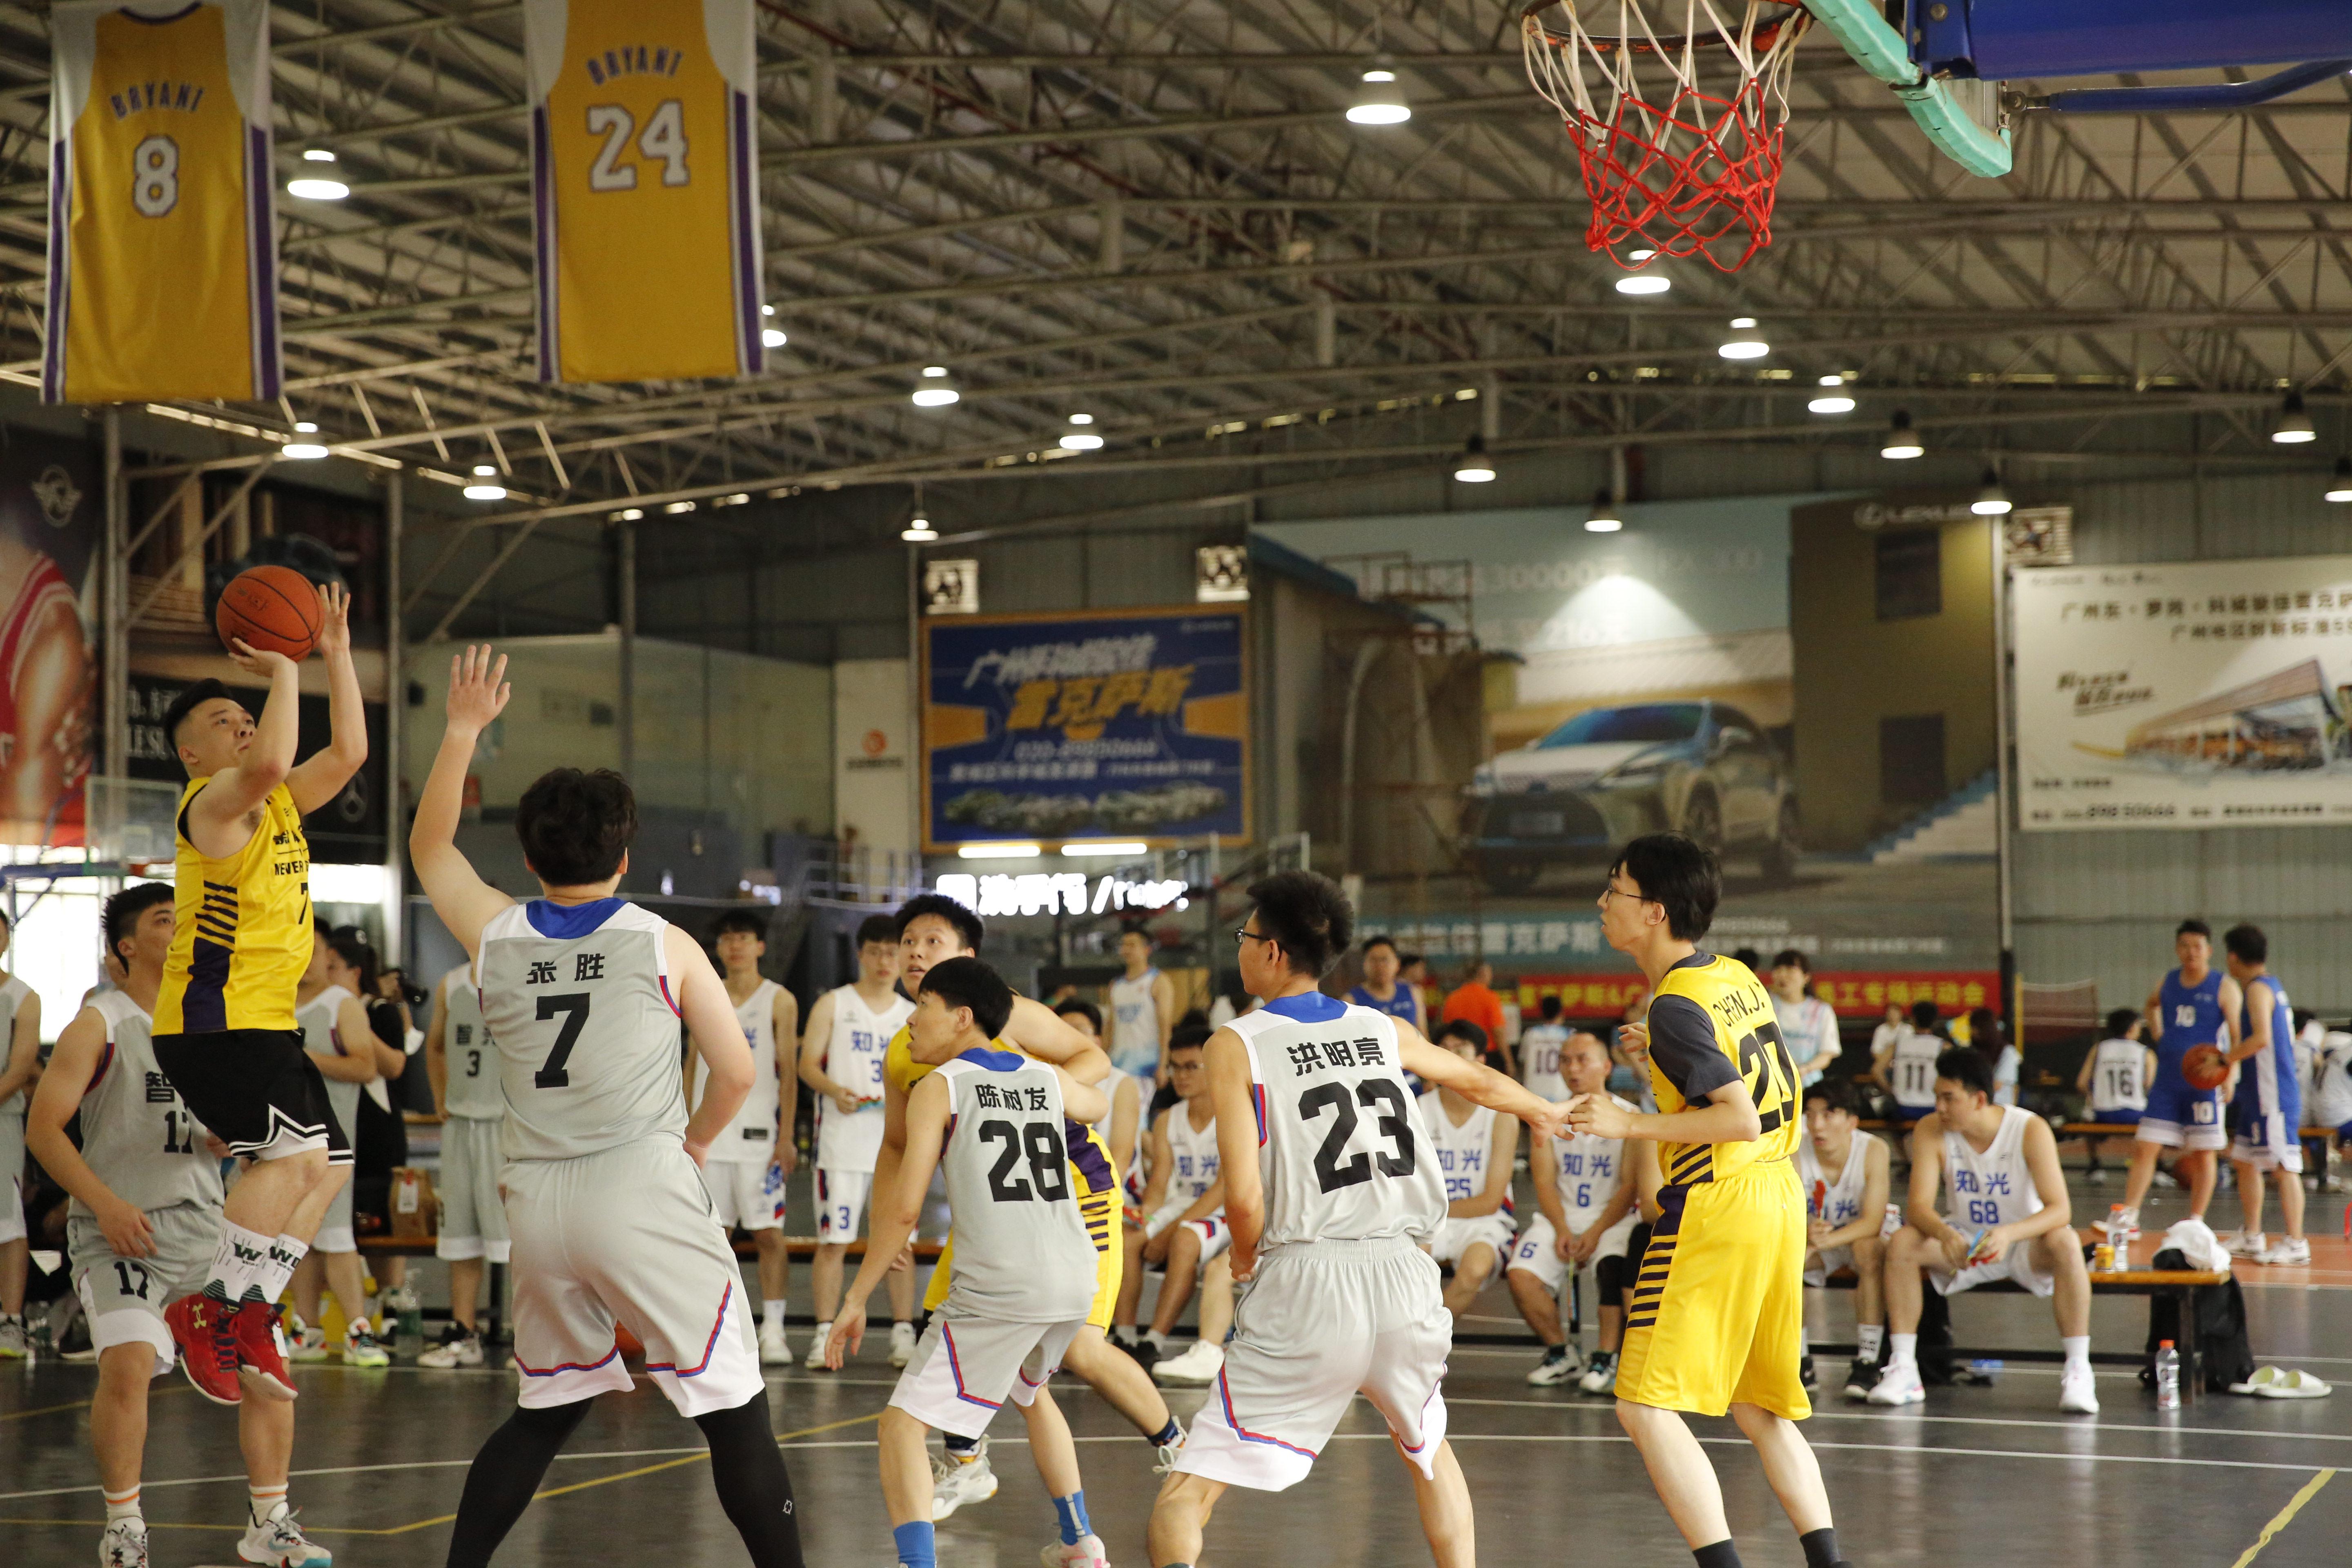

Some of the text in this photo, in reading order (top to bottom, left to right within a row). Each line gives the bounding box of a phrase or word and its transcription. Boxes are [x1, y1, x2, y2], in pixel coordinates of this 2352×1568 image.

[586, 45, 684, 85] BRYANT
[109, 80, 204, 120] BRYANT
[586, 98, 690, 192] 24
[133, 134, 179, 218] 8
[274, 861, 303, 876] NEVER
[526, 953, 605, 985] 张胜
[535, 993, 590, 1089] 7
[467, 1049, 481, 1077] 3
[871, 1060, 882, 1082] 3
[1287, 1037, 1385, 1076] 洪明亮
[1906, 1064, 1925, 1092] 11
[2107, 1068, 2134, 1098] 16
[975, 1083, 1049, 1113] 陈树发
[1298, 1078, 1415, 1194] 23
[979, 1120, 1069, 1202] 28
[1564, 1153, 1611, 1177] 知光
[1445, 1178, 1471, 1202] 25
[1577, 1183, 1591, 1208] 6
[1956, 1170, 2010, 1195] 知光
[839, 1206, 850, 1229] 3
[1970, 1200, 1999, 1224] 68
[1519, 1241, 1538, 1258] 6
[114, 1261, 148, 1300] 17
